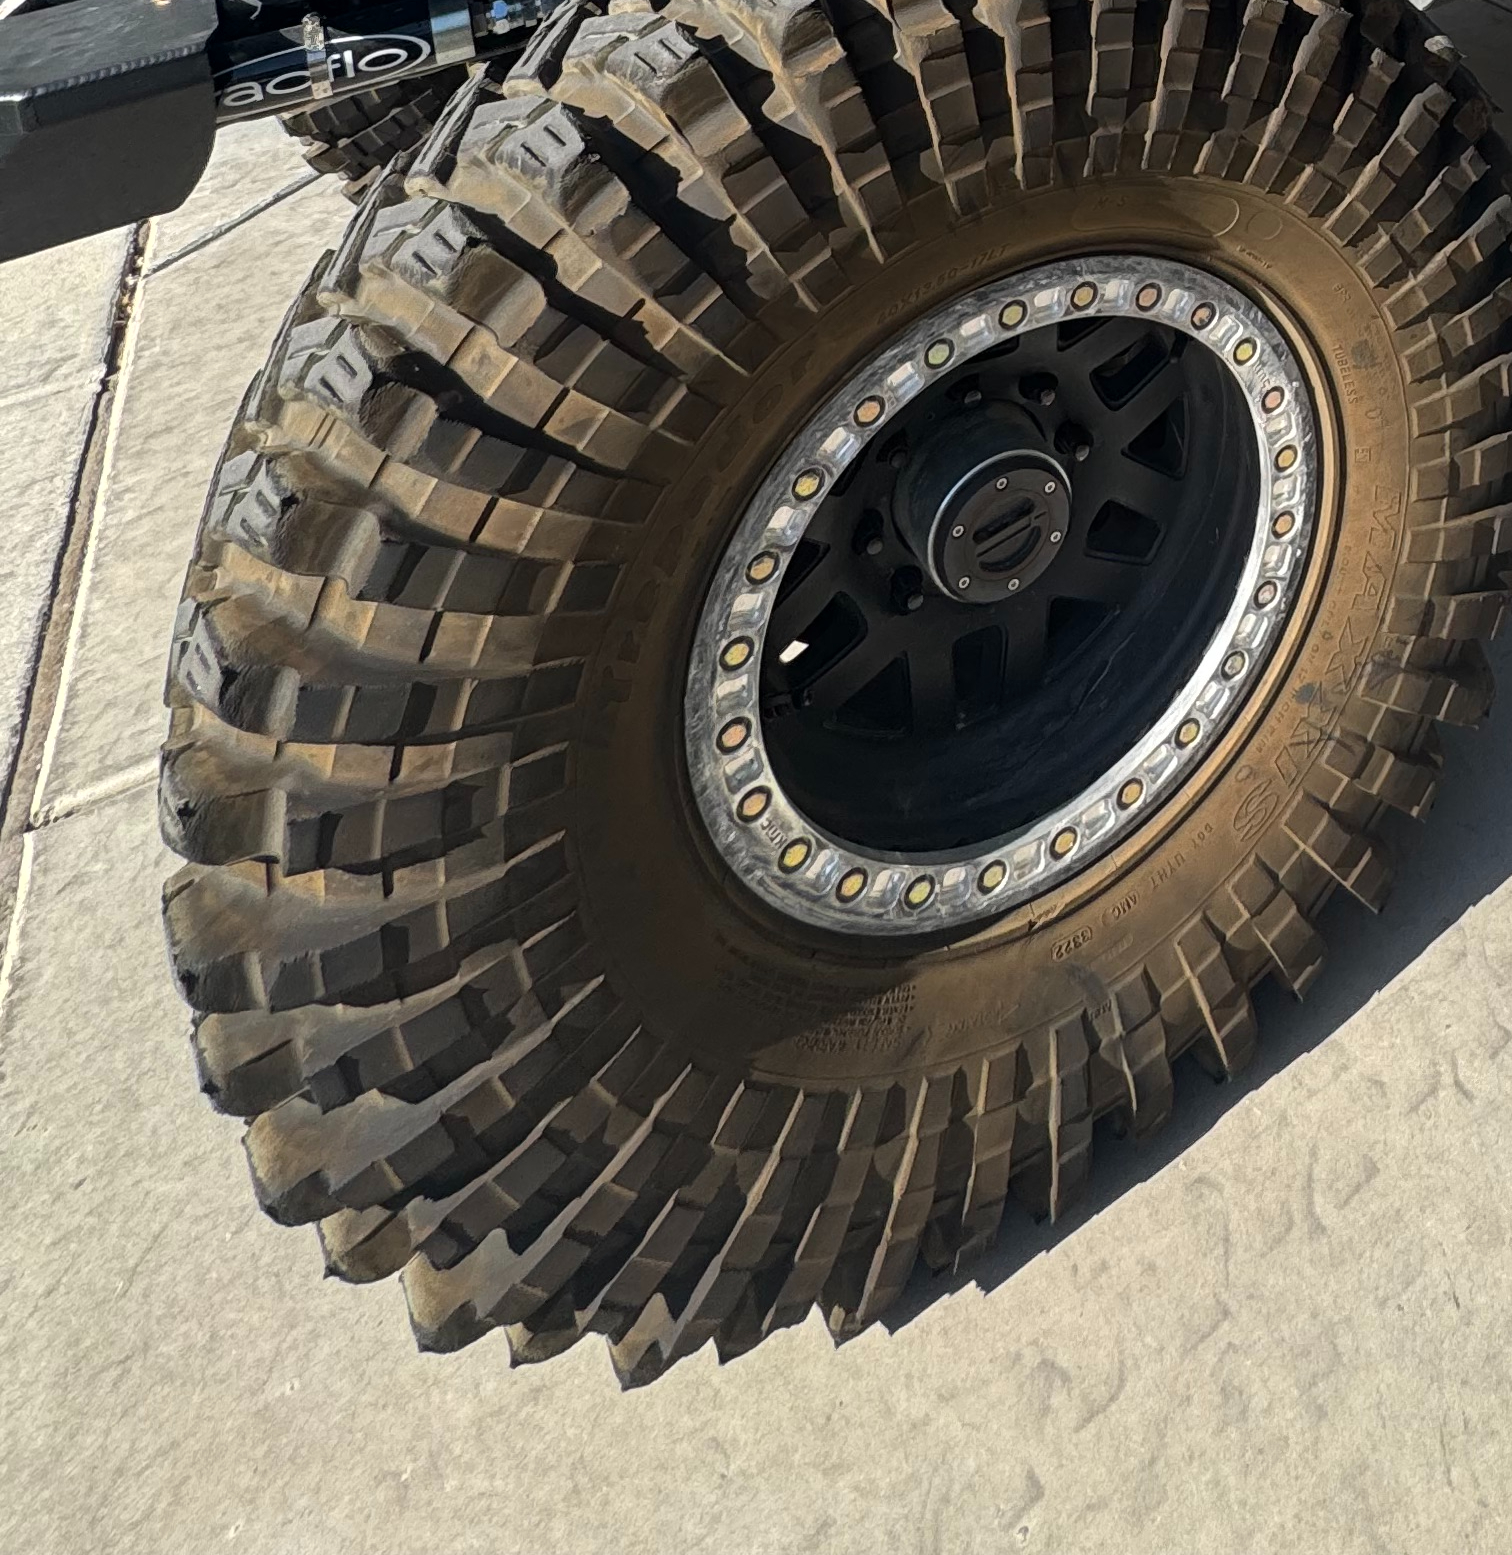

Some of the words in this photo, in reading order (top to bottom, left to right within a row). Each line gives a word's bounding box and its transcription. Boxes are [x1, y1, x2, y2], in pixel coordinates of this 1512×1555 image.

[213, 48, 409, 107] aflo
[1331, 344, 1359, 406] TUBELESS
[1226, 484, 1402, 842] MAXXIS
